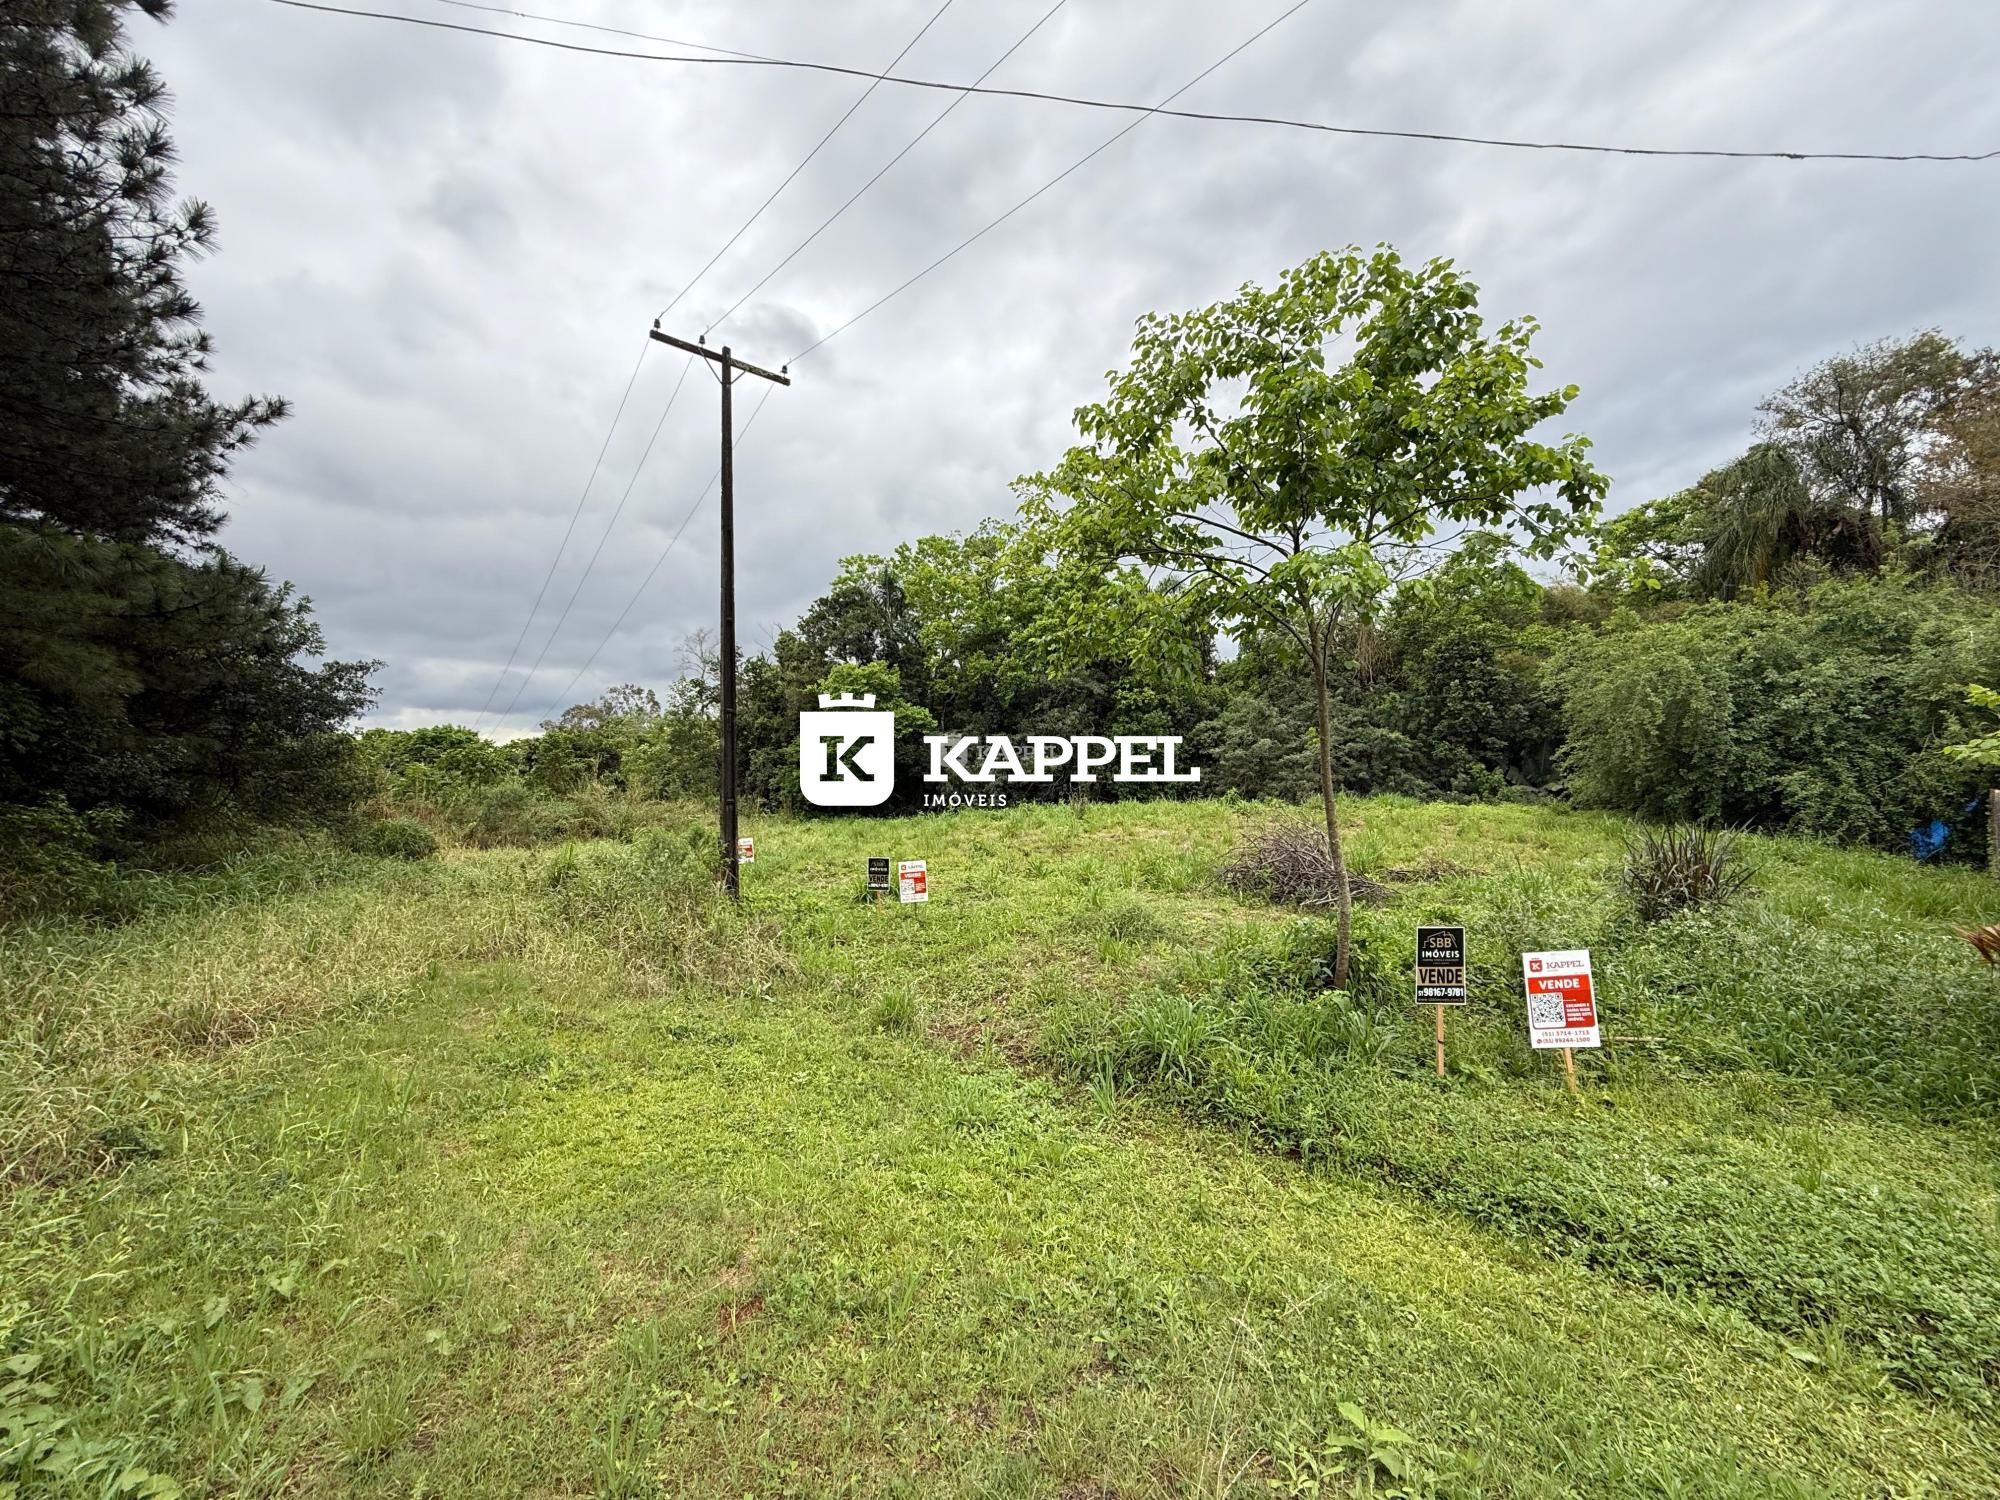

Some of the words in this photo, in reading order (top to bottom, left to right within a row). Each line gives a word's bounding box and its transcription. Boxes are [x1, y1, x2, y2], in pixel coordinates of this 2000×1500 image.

[1429, 937, 1452, 948] SBB
[1421, 948, 1460, 958] IMÓVEIS
[1546, 960, 1585, 969] KAPPEL
[1419, 968, 1463, 984] VENDE
[1538, 978, 1581, 990] VENDE
